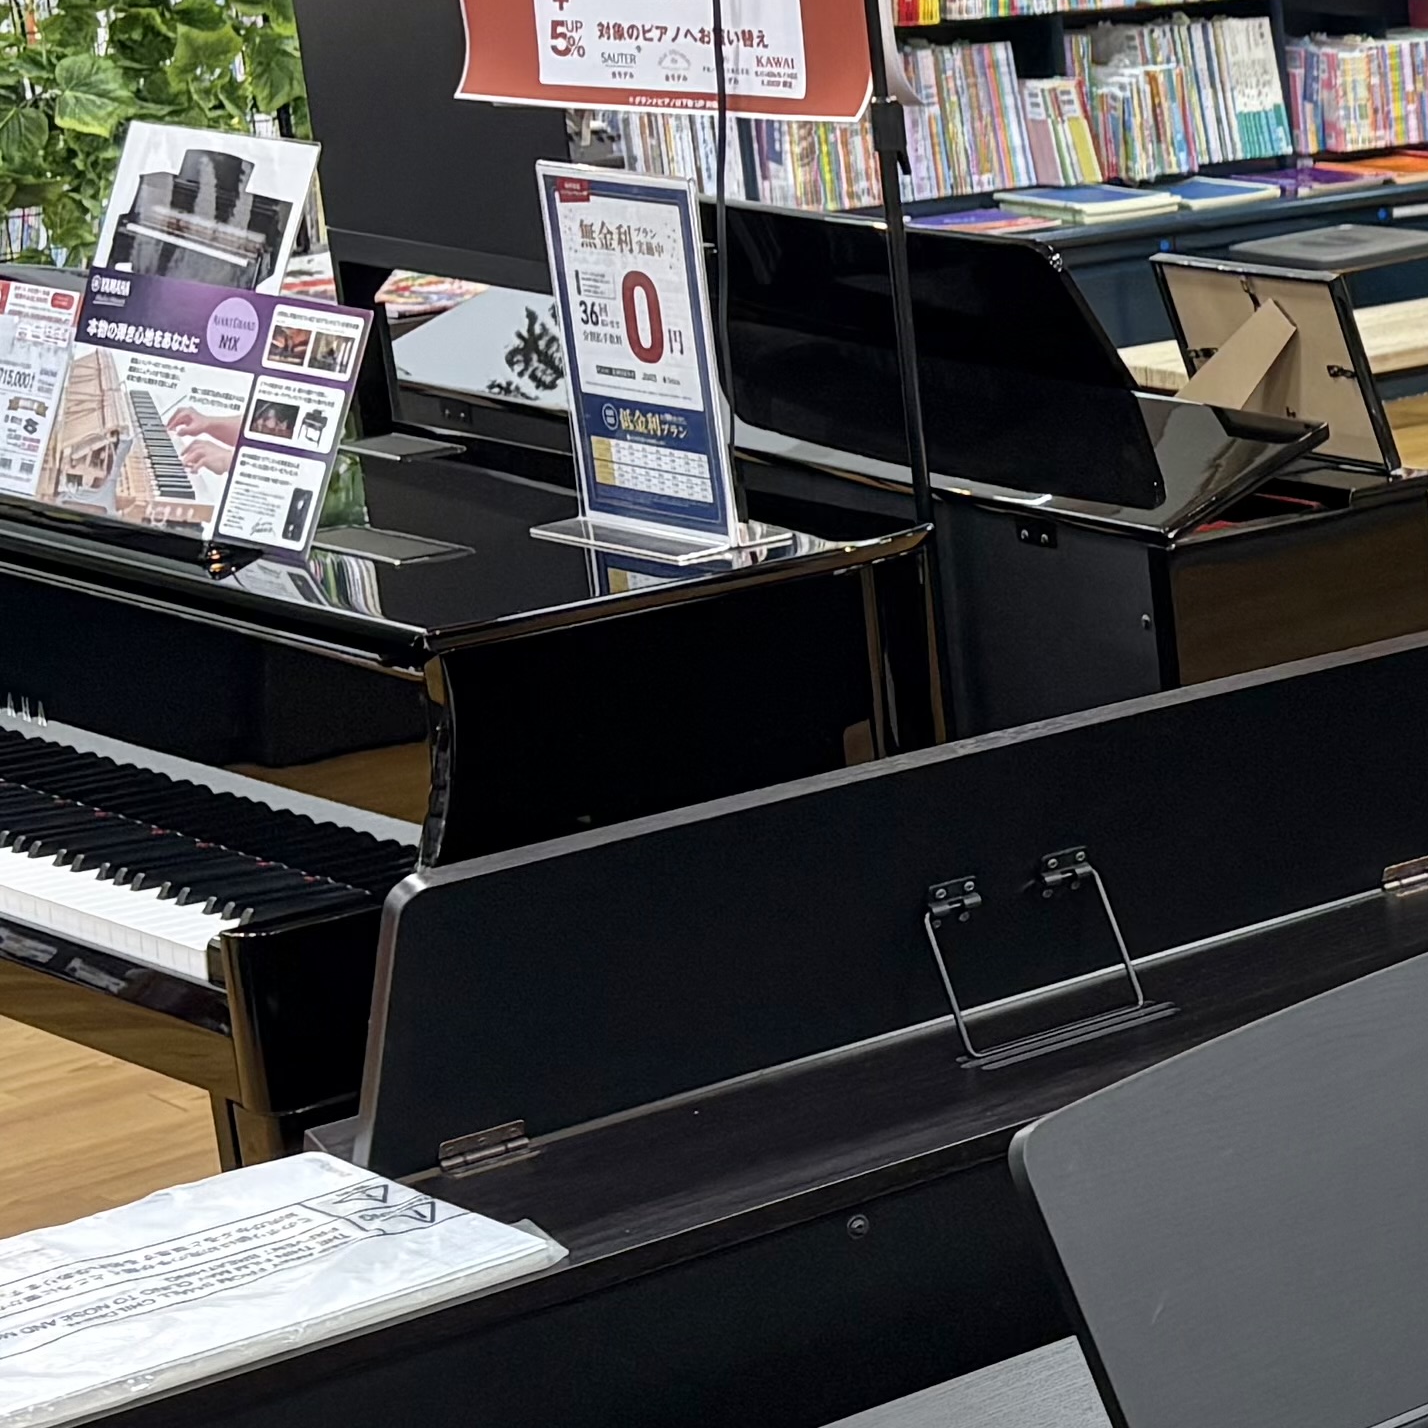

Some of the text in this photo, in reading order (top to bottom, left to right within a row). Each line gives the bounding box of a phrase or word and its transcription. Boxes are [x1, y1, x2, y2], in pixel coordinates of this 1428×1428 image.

[755, 55, 795, 70] KAWAI
[580, 219, 633, 254] 無金利
[634, 227, 657, 239] プラン
[101, 278, 131, 297] YAMAHA
[622, 270, 664, 364] 0
[86, 318, 201, 354] 本物の弾き心地をあなたに
[668, 328, 684, 355] 円
[620, 408, 661, 437] 低金利
[661, 423, 688, 439] プラン
[59, 1300, 109, 1323] NOSE
[18, 1317, 55, 1336] AND
